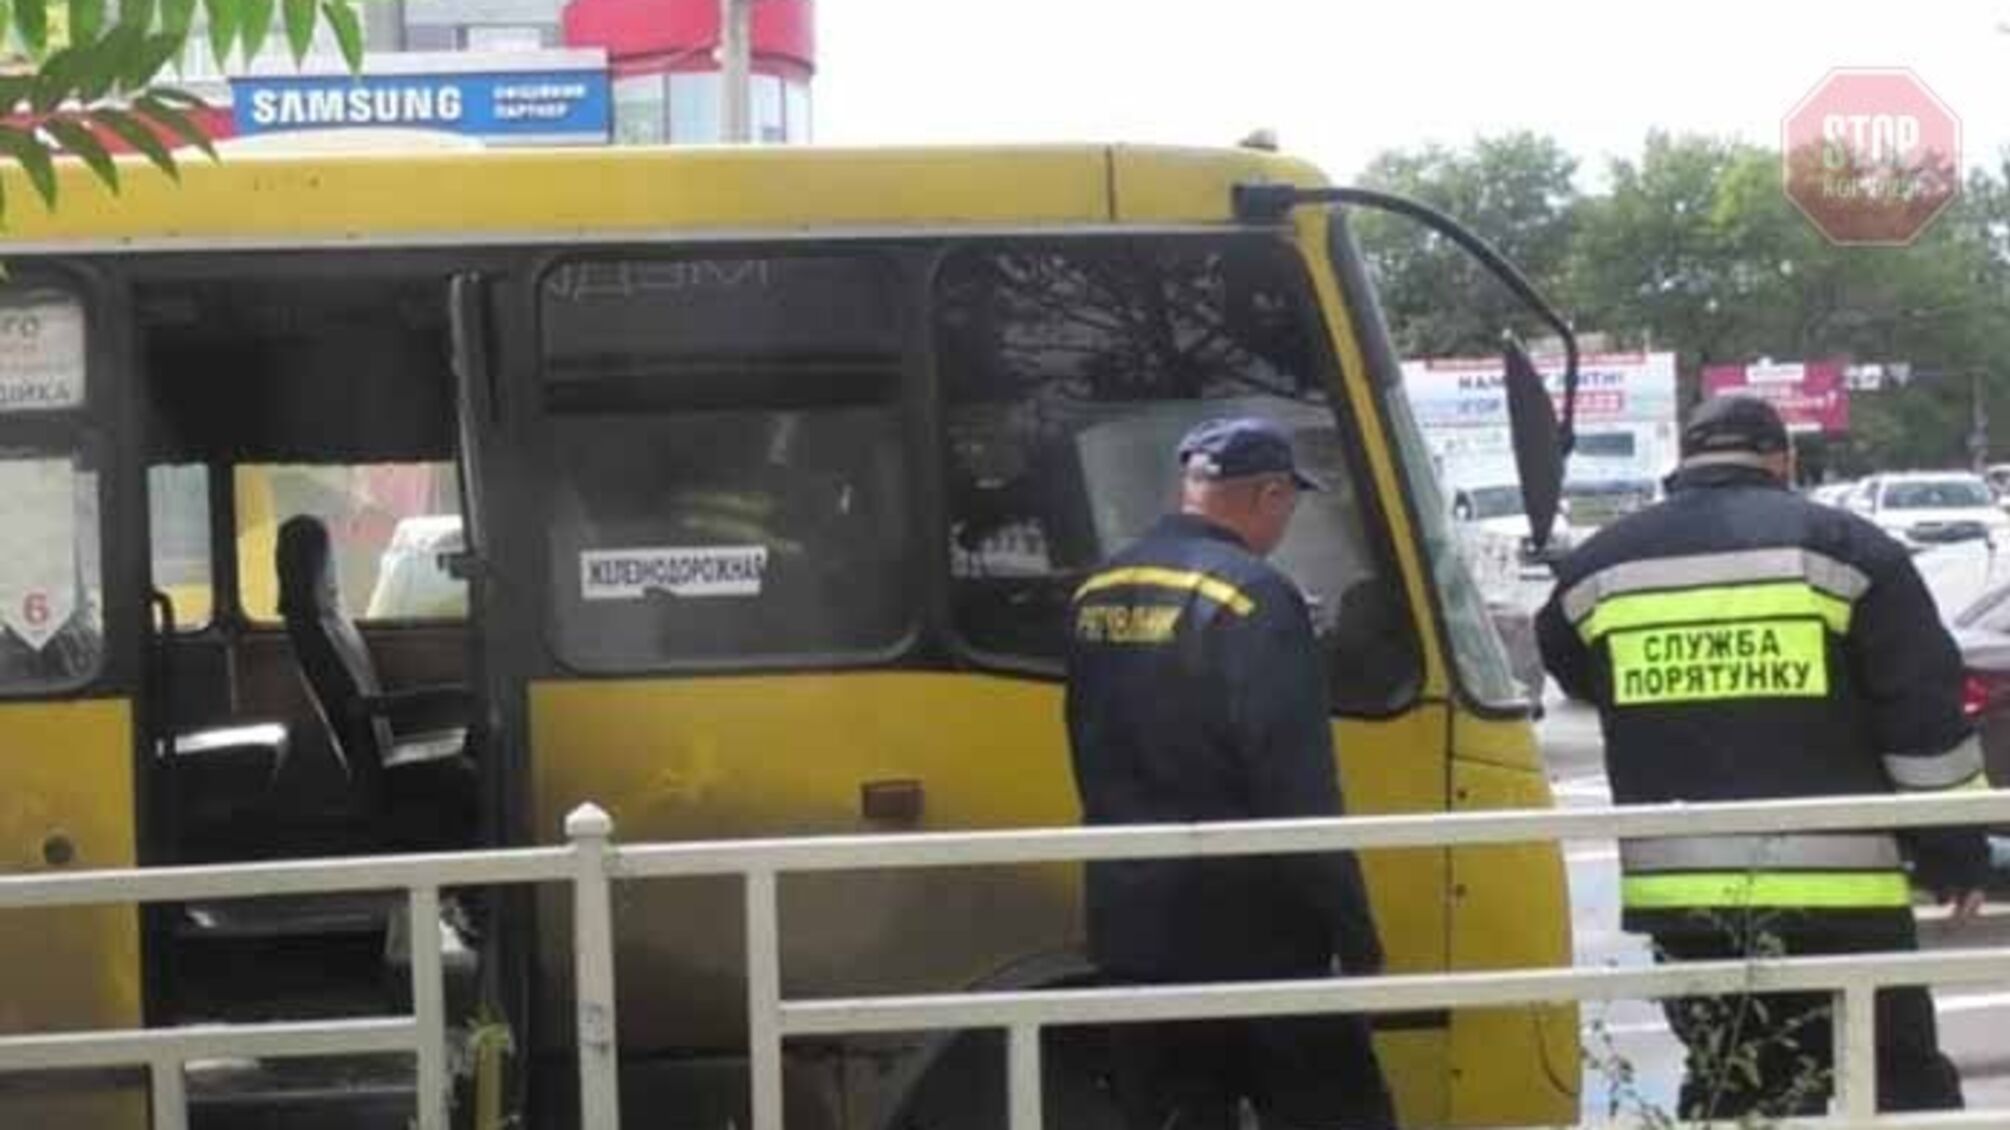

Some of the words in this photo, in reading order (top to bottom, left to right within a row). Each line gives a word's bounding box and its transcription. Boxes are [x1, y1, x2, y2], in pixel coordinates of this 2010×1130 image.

[253, 85, 464, 124] SAMSUNG
[22, 594, 50, 625] 6
[1643, 629, 1781, 663] СЛУЖБА
[1624, 662, 1811, 696] ПОРЯТУНКУ
